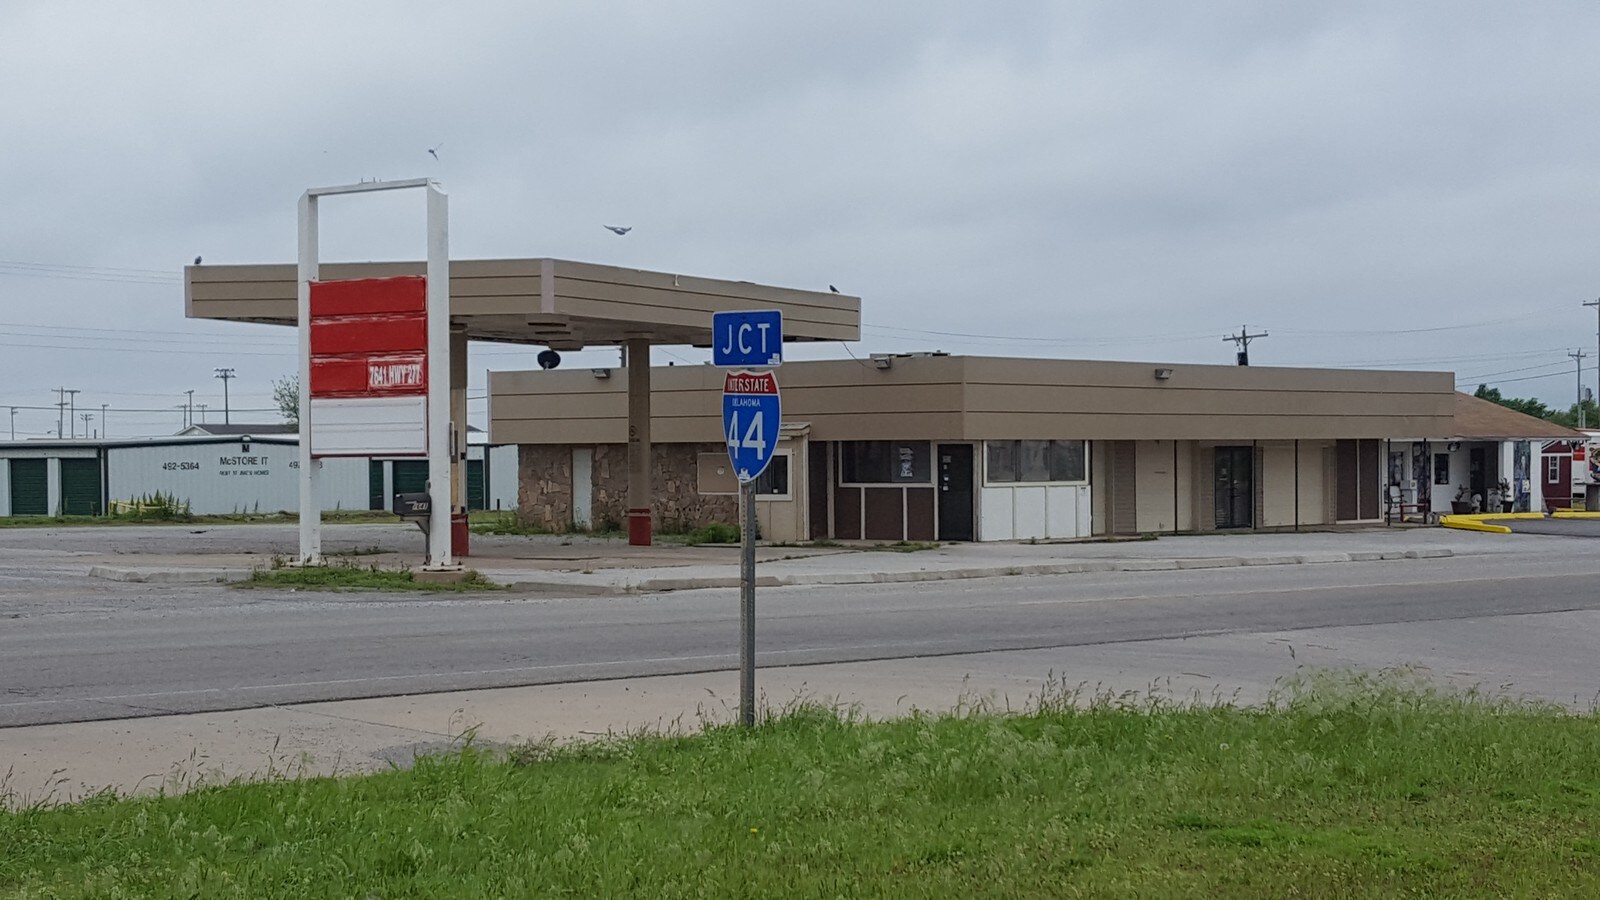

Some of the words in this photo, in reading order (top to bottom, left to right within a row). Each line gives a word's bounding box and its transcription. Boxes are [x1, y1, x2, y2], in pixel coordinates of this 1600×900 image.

[722, 323, 770, 354] JCT
[389, 365, 407, 384] HWY
[728, 379, 769, 392] INTERSTATE
[732, 398, 761, 407] OKLAHOMA
[728, 410, 766, 460] 44
[162, 462, 199, 470] 492-5364
[220, 457, 258, 466] McSTORE
[261, 457, 268, 465] IT
